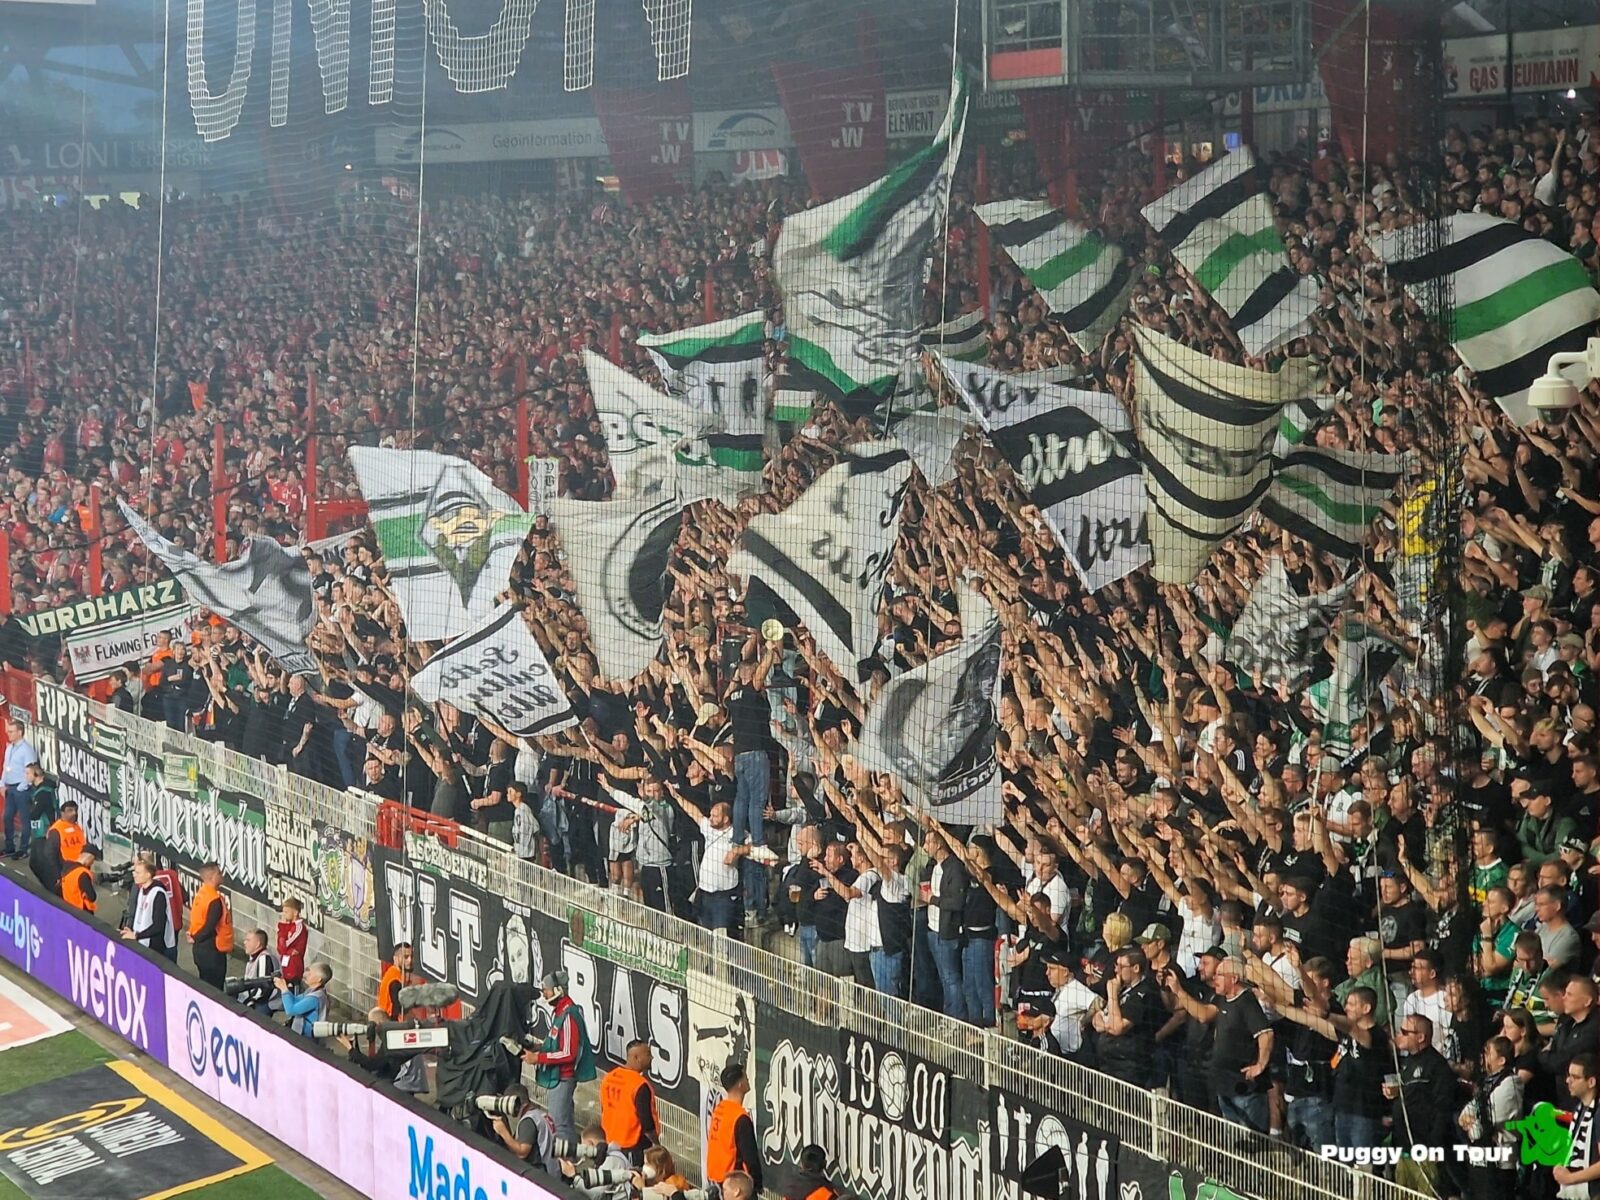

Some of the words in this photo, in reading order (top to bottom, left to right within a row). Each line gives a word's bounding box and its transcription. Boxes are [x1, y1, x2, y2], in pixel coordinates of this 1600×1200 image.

[1469, 67, 1499, 92] GAS
[492, 132, 592, 149] Geoinformation
[888, 111, 935, 133] ELEMENT
[115, 747, 268, 893] Niederrhein
[67, 938, 148, 1049] wefox
[210, 1026, 260, 1099] eaw
[408, 1125, 488, 1200] Mad
